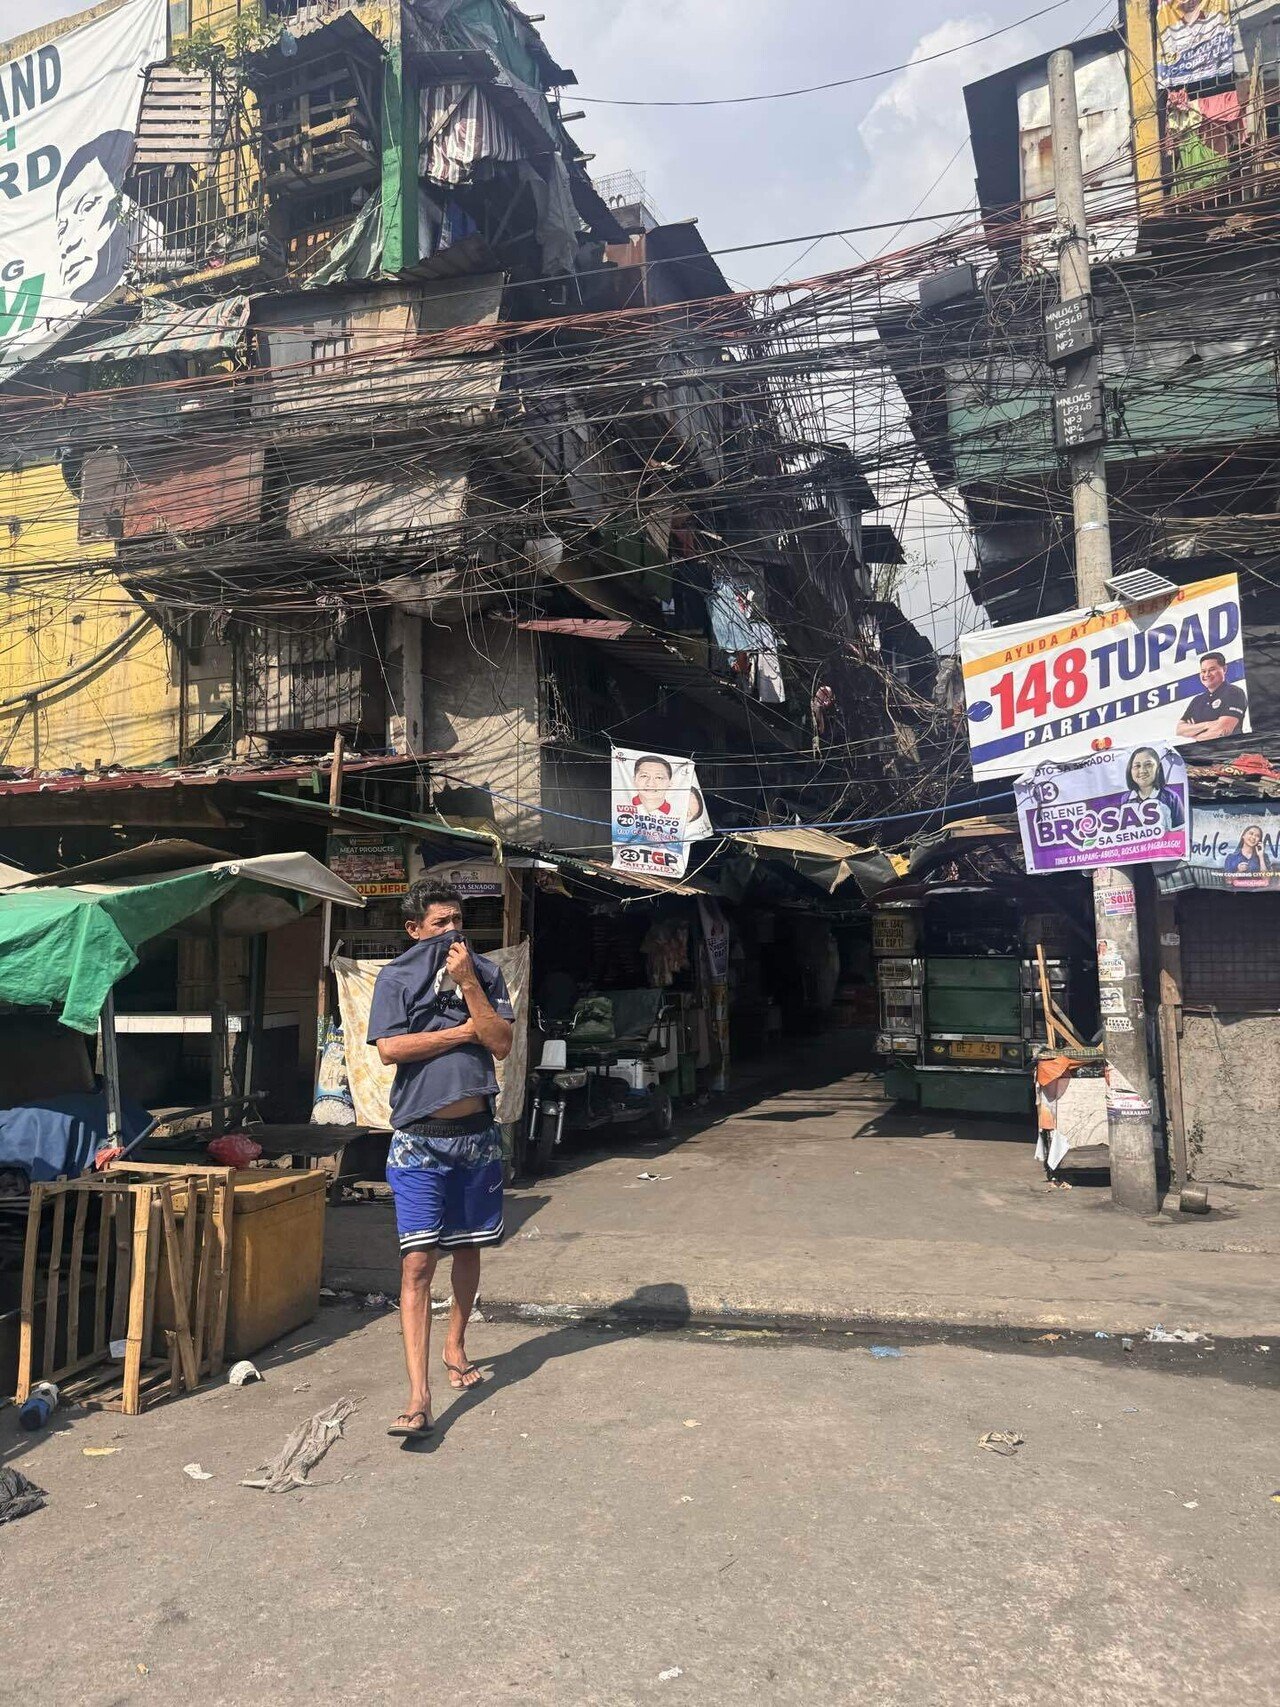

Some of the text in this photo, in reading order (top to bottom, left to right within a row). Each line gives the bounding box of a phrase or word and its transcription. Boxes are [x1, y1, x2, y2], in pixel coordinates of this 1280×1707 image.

[1057, 338, 1074, 352] NP2
[1005, 637, 1058, 662] AYUDA
[1070, 624, 1088, 640] AT
[990, 601, 1239, 729] 148 TUPAD
[1024, 683, 1179, 749] PARTYLIST
[1039, 782, 1056, 802] 13
[621, 816, 634, 826] 20
[635, 814, 679, 827] PEDROZO
[1038, 806, 1084, 821] RLENE
[635, 821, 663, 833] PAPA
[1098, 827, 1162, 846] SA SENADO
[622, 850, 637, 860] 23
[640, 849, 678, 866] TGP
[356, 884, 408, 894] OLD HERE
